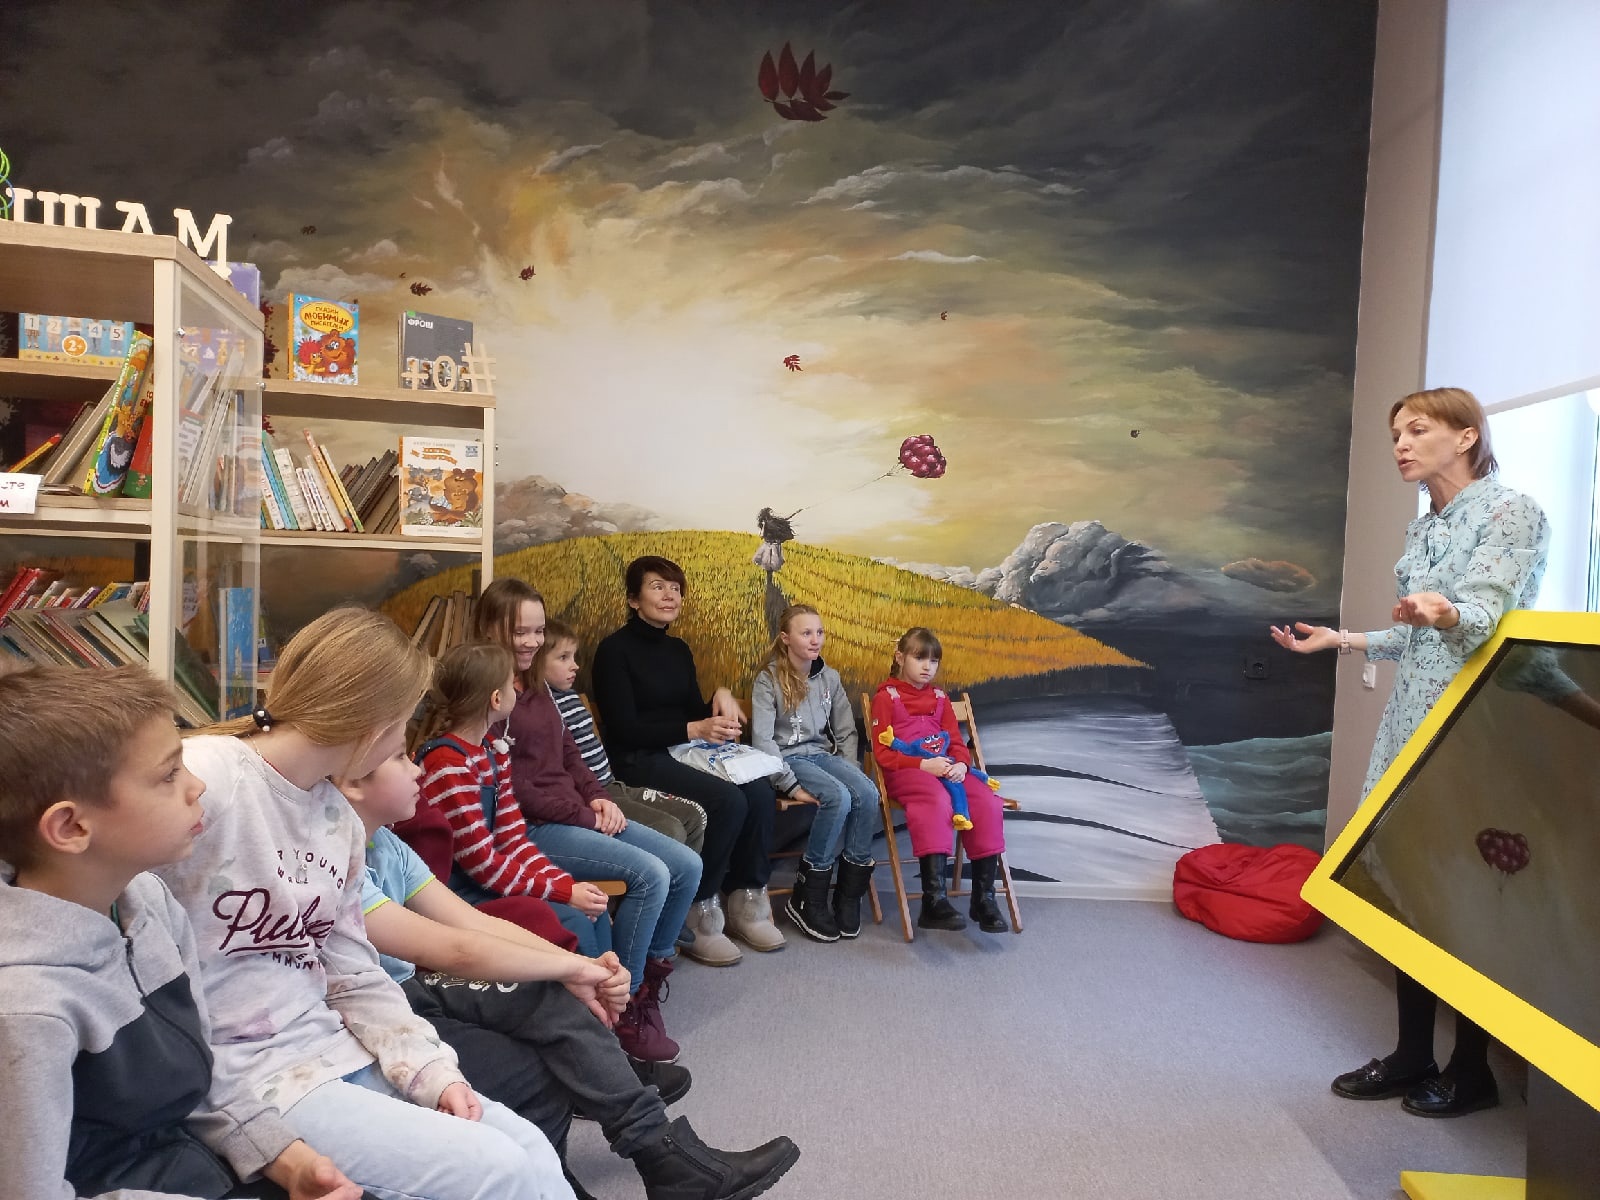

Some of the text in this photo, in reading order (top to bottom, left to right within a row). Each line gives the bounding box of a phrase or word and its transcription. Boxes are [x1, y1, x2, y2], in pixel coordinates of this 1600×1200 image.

[91, 326, 99, 335] 4
[113, 328, 121, 339] 5
[68, 340, 83, 352] 2+
[293, 848, 344, 890] YOUNG
